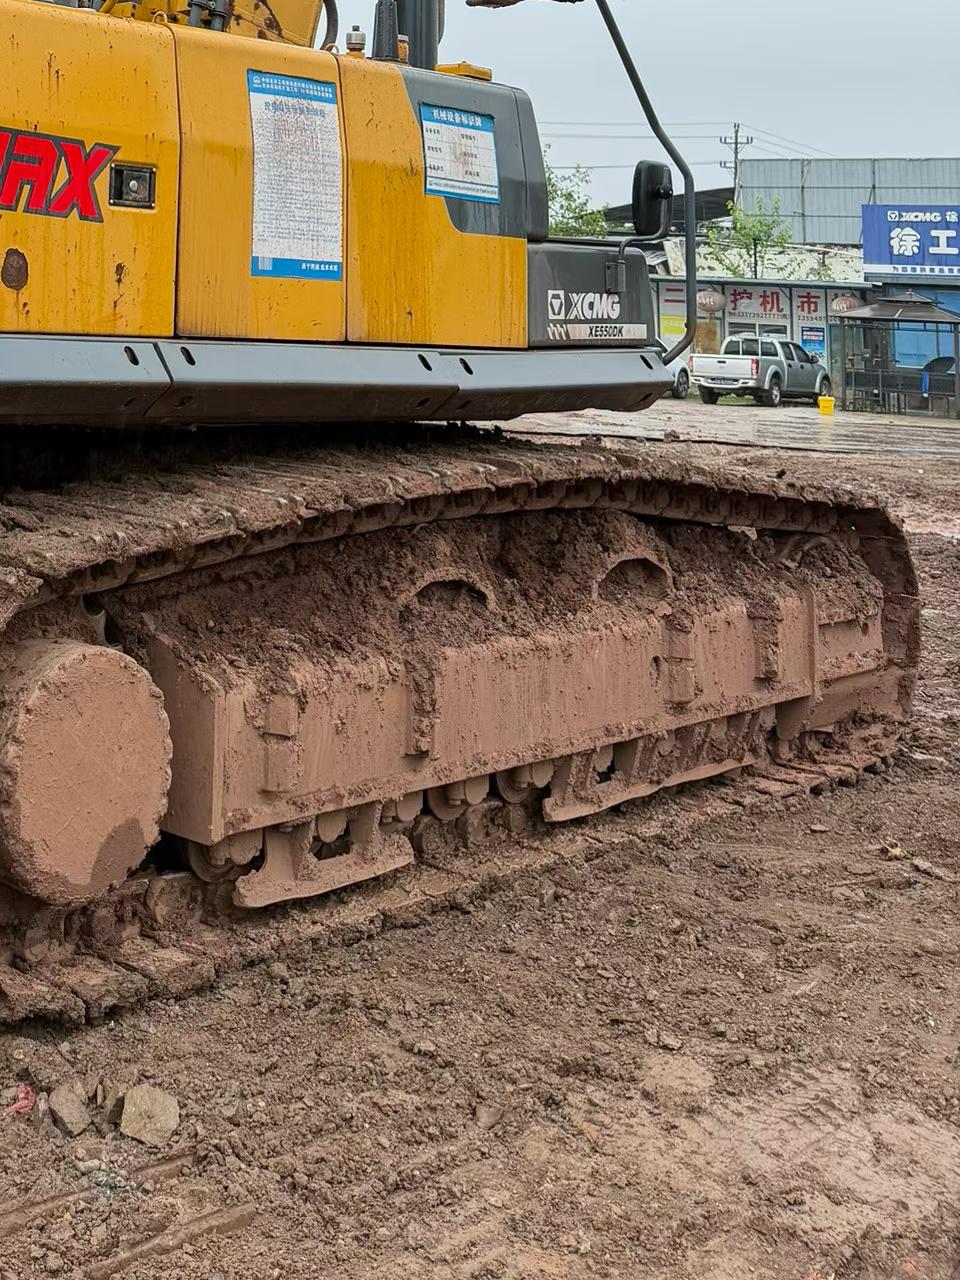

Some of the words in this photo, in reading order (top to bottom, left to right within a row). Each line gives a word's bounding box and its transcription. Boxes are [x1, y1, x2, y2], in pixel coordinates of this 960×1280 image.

[900, 211, 942, 222] XCMG
[889, 227, 960, 256] 徐工
[566, 292, 620, 320] XCMG
[587, 325, 625, 338] XE550DK
